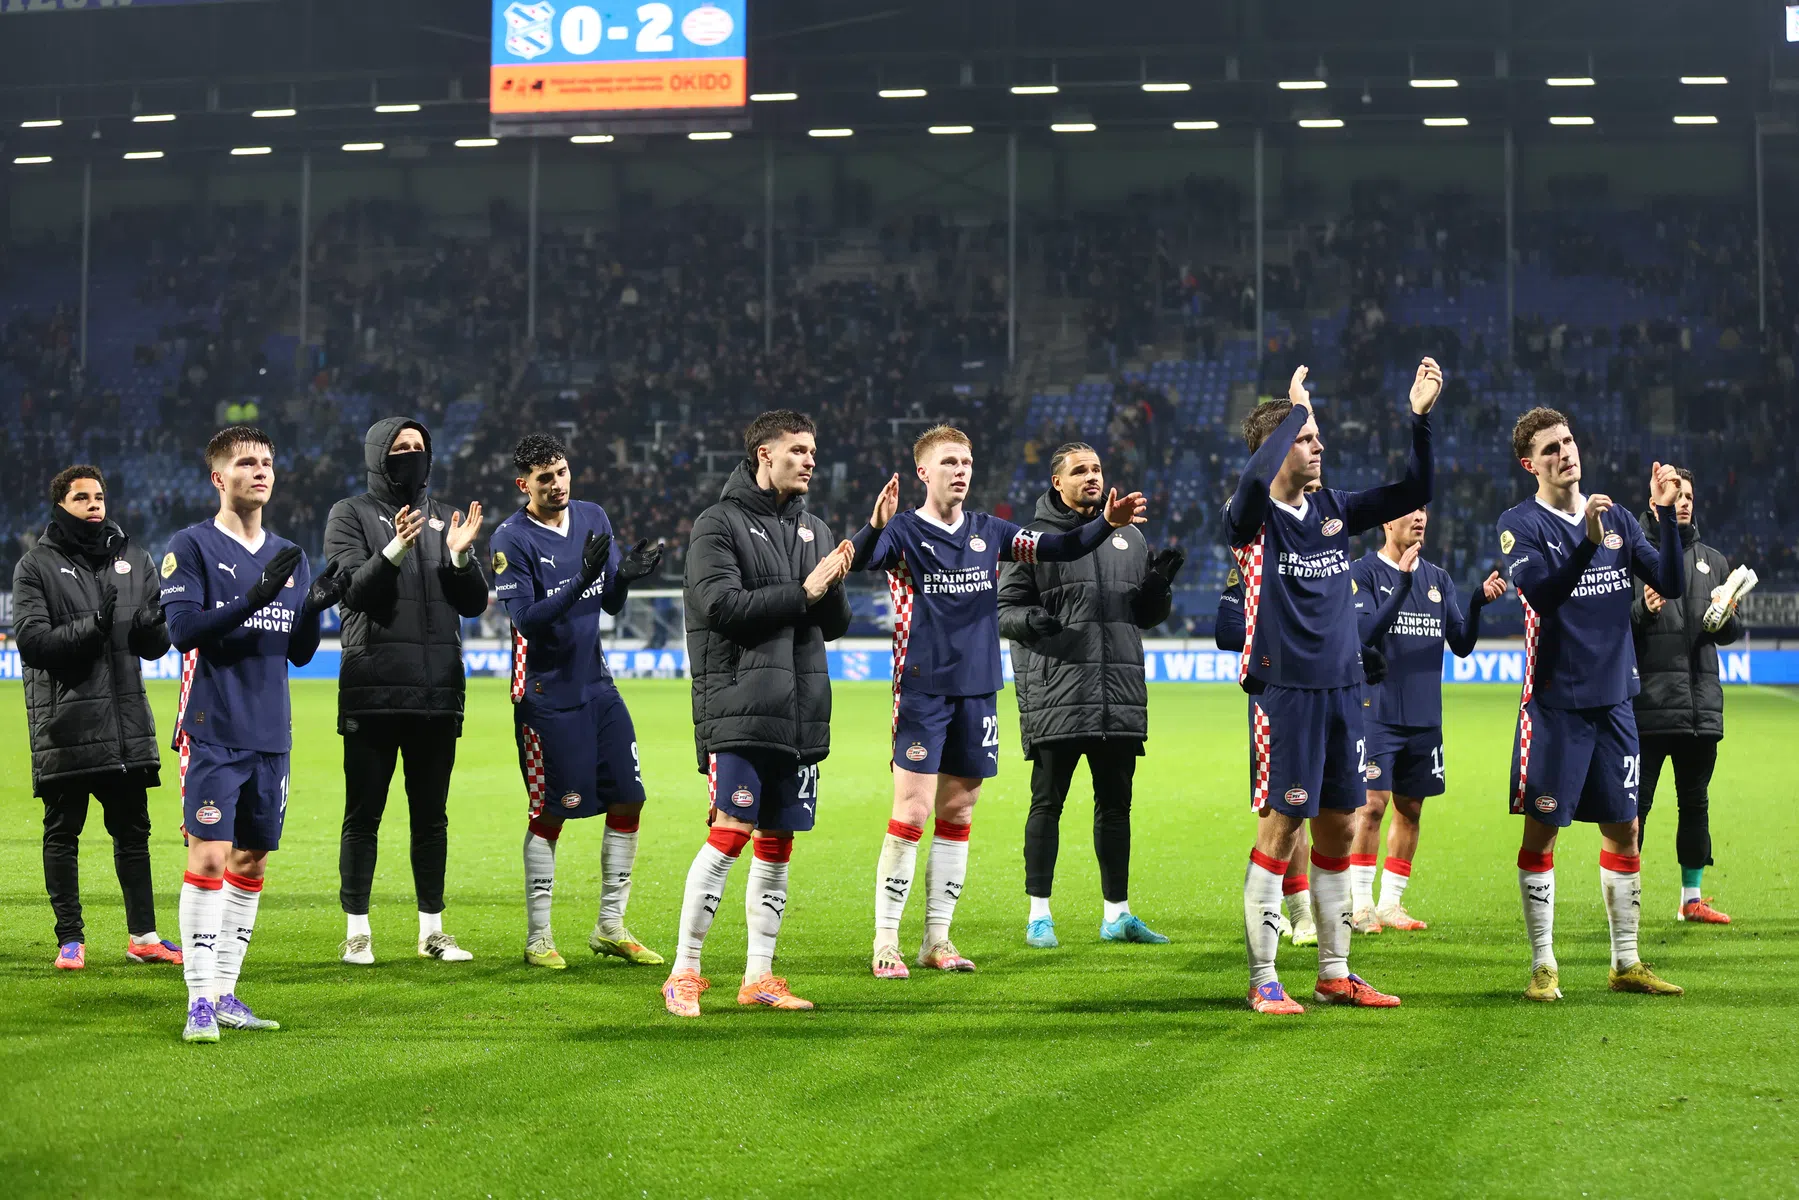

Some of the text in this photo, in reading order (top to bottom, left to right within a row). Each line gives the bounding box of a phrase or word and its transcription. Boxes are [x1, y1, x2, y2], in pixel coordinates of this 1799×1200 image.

[670, 74, 732, 92] OKIDO
[924, 569, 989, 583] BRAINPORT
[1278, 560, 1350, 578] EINDHOVEN
[1578, 567, 1627, 585] INPORT
[1571, 578, 1632, 598] NDHOVEN
[1394, 616, 1442, 628] AINPORT
[1388, 624, 1443, 637] INDHOVEN
[1164, 652, 1242, 680] WER
[797, 763, 817, 799] 27
[885, 877, 908, 885] PSV
[1527, 884, 1550, 892] PSV
[762, 894, 786, 904] PSV
